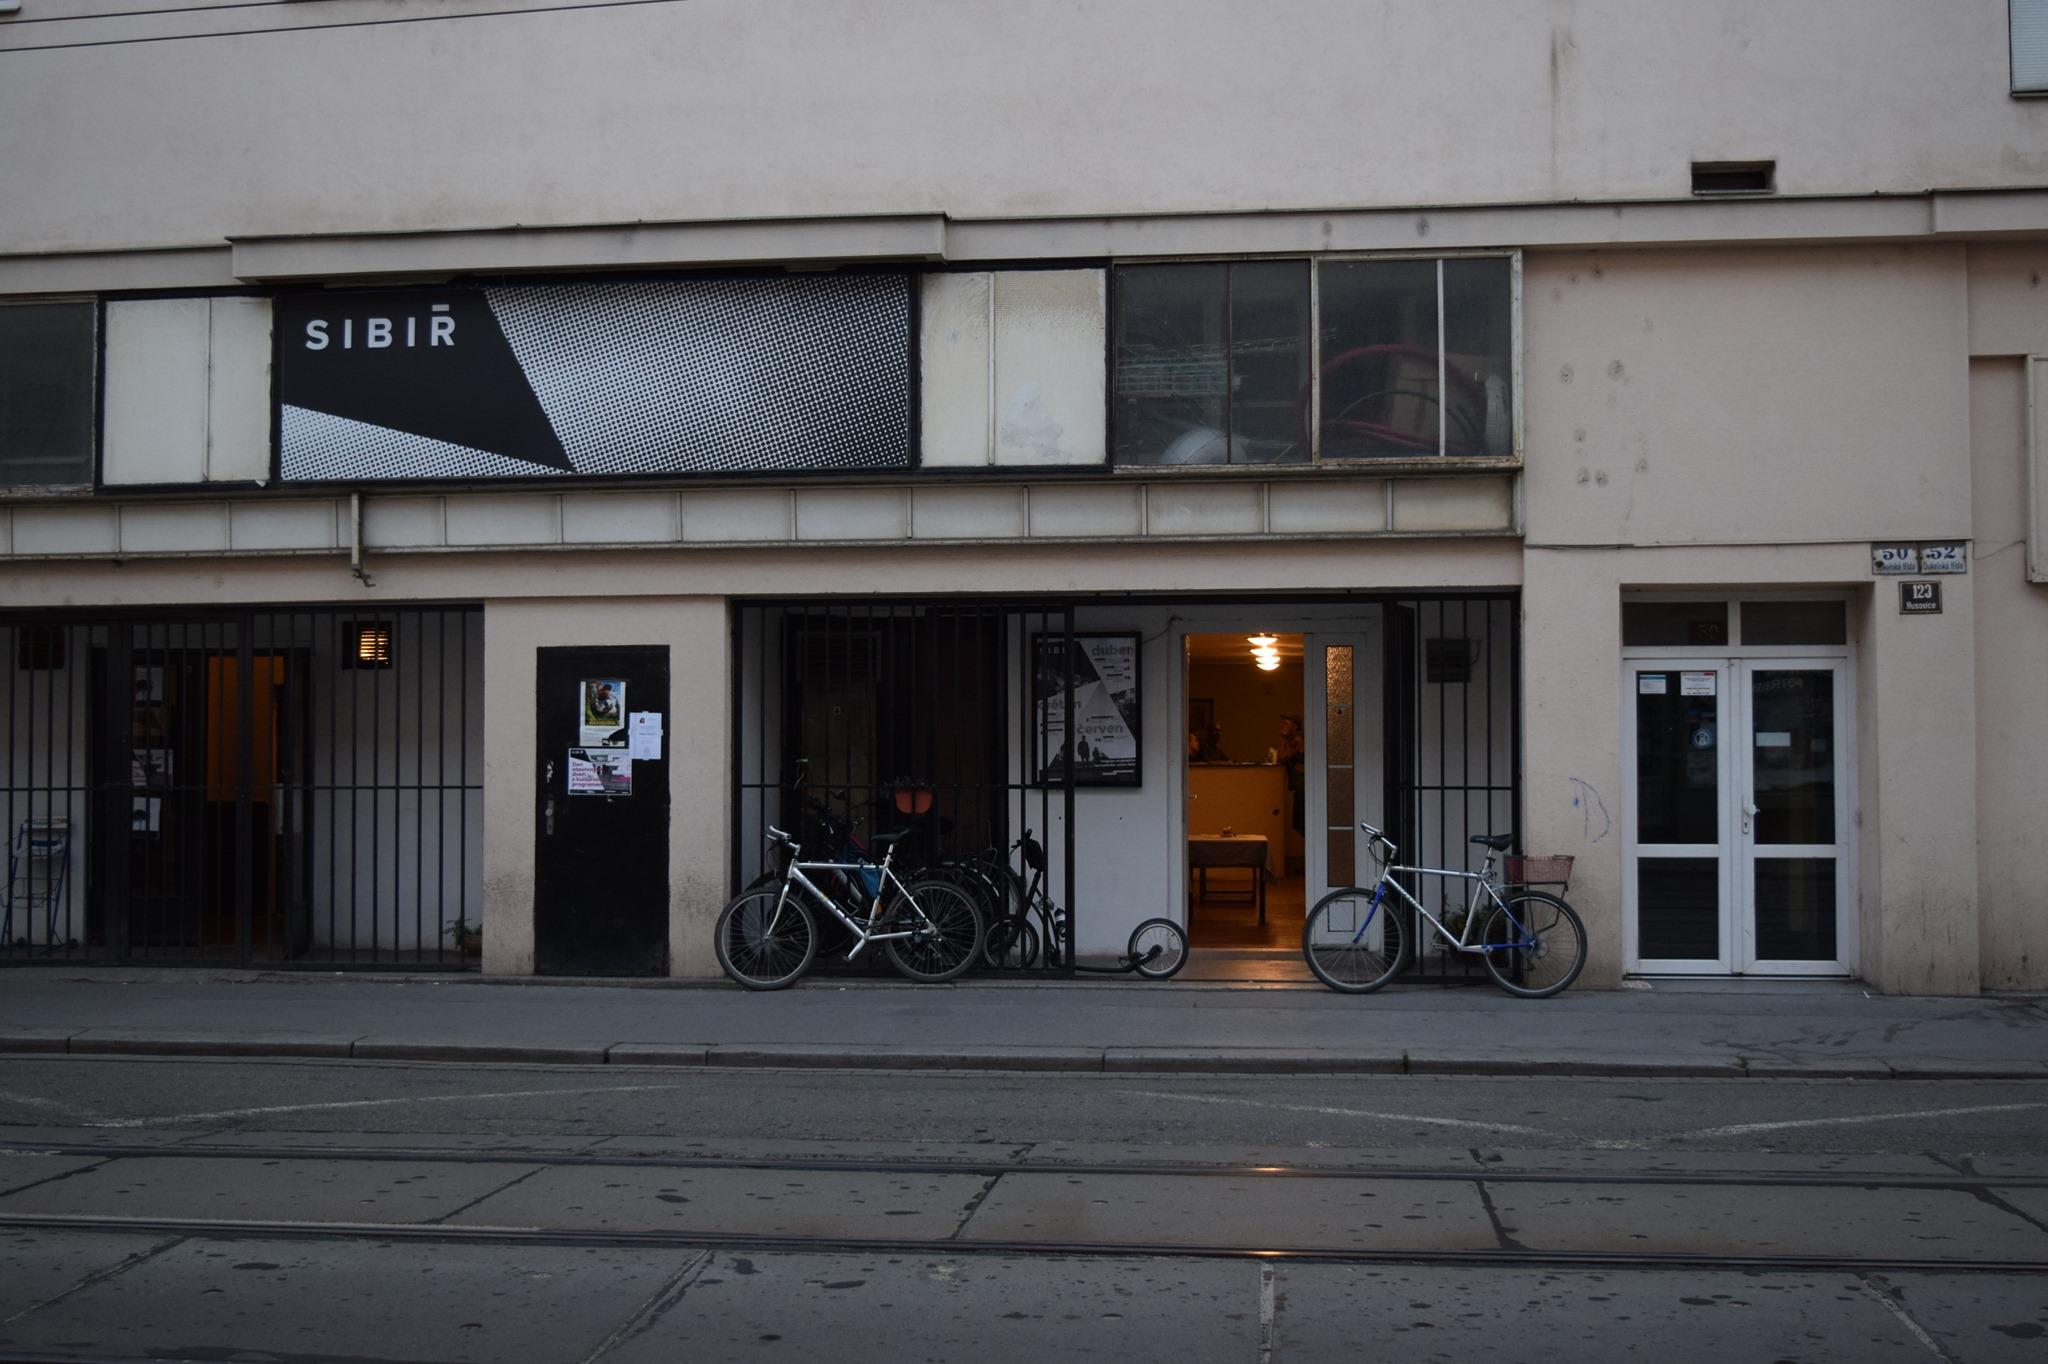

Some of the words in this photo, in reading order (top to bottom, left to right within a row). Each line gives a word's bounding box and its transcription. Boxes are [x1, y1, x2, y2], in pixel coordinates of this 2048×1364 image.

[1912, 584, 1932, 599] 123
[1906, 601, 1936, 610] Husovice
[1091, 645, 1133, 656] duben
